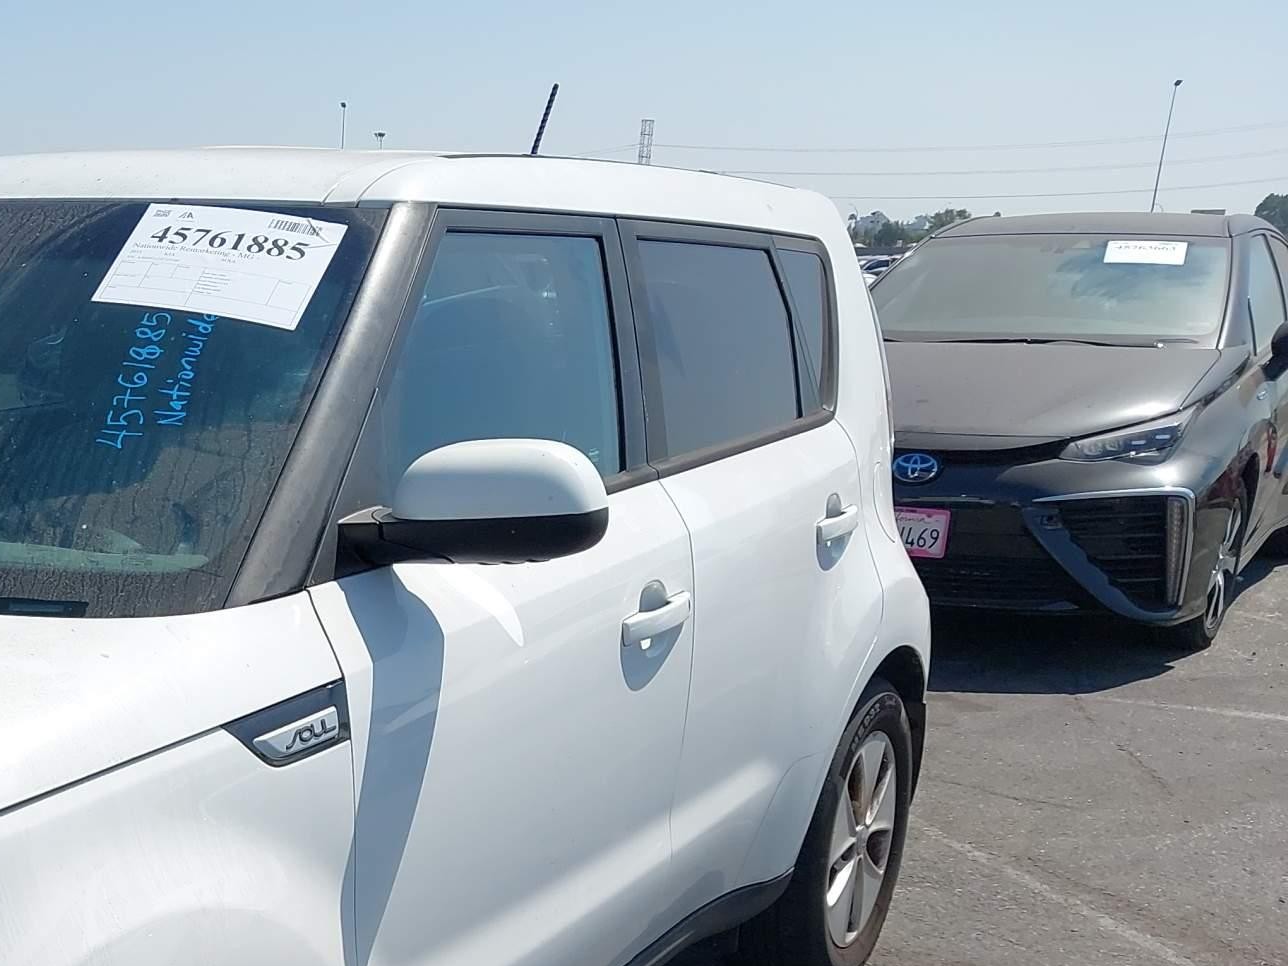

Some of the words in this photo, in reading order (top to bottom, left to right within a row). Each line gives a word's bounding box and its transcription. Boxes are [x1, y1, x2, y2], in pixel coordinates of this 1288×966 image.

[135, 243, 178, 251] Nationwide
[179, 246, 231, 258] Remarketing
[150, 226, 310, 260] 45761885
[96, 312, 173, 449] 45761885
[286, 719, 336, 750] SOUL
